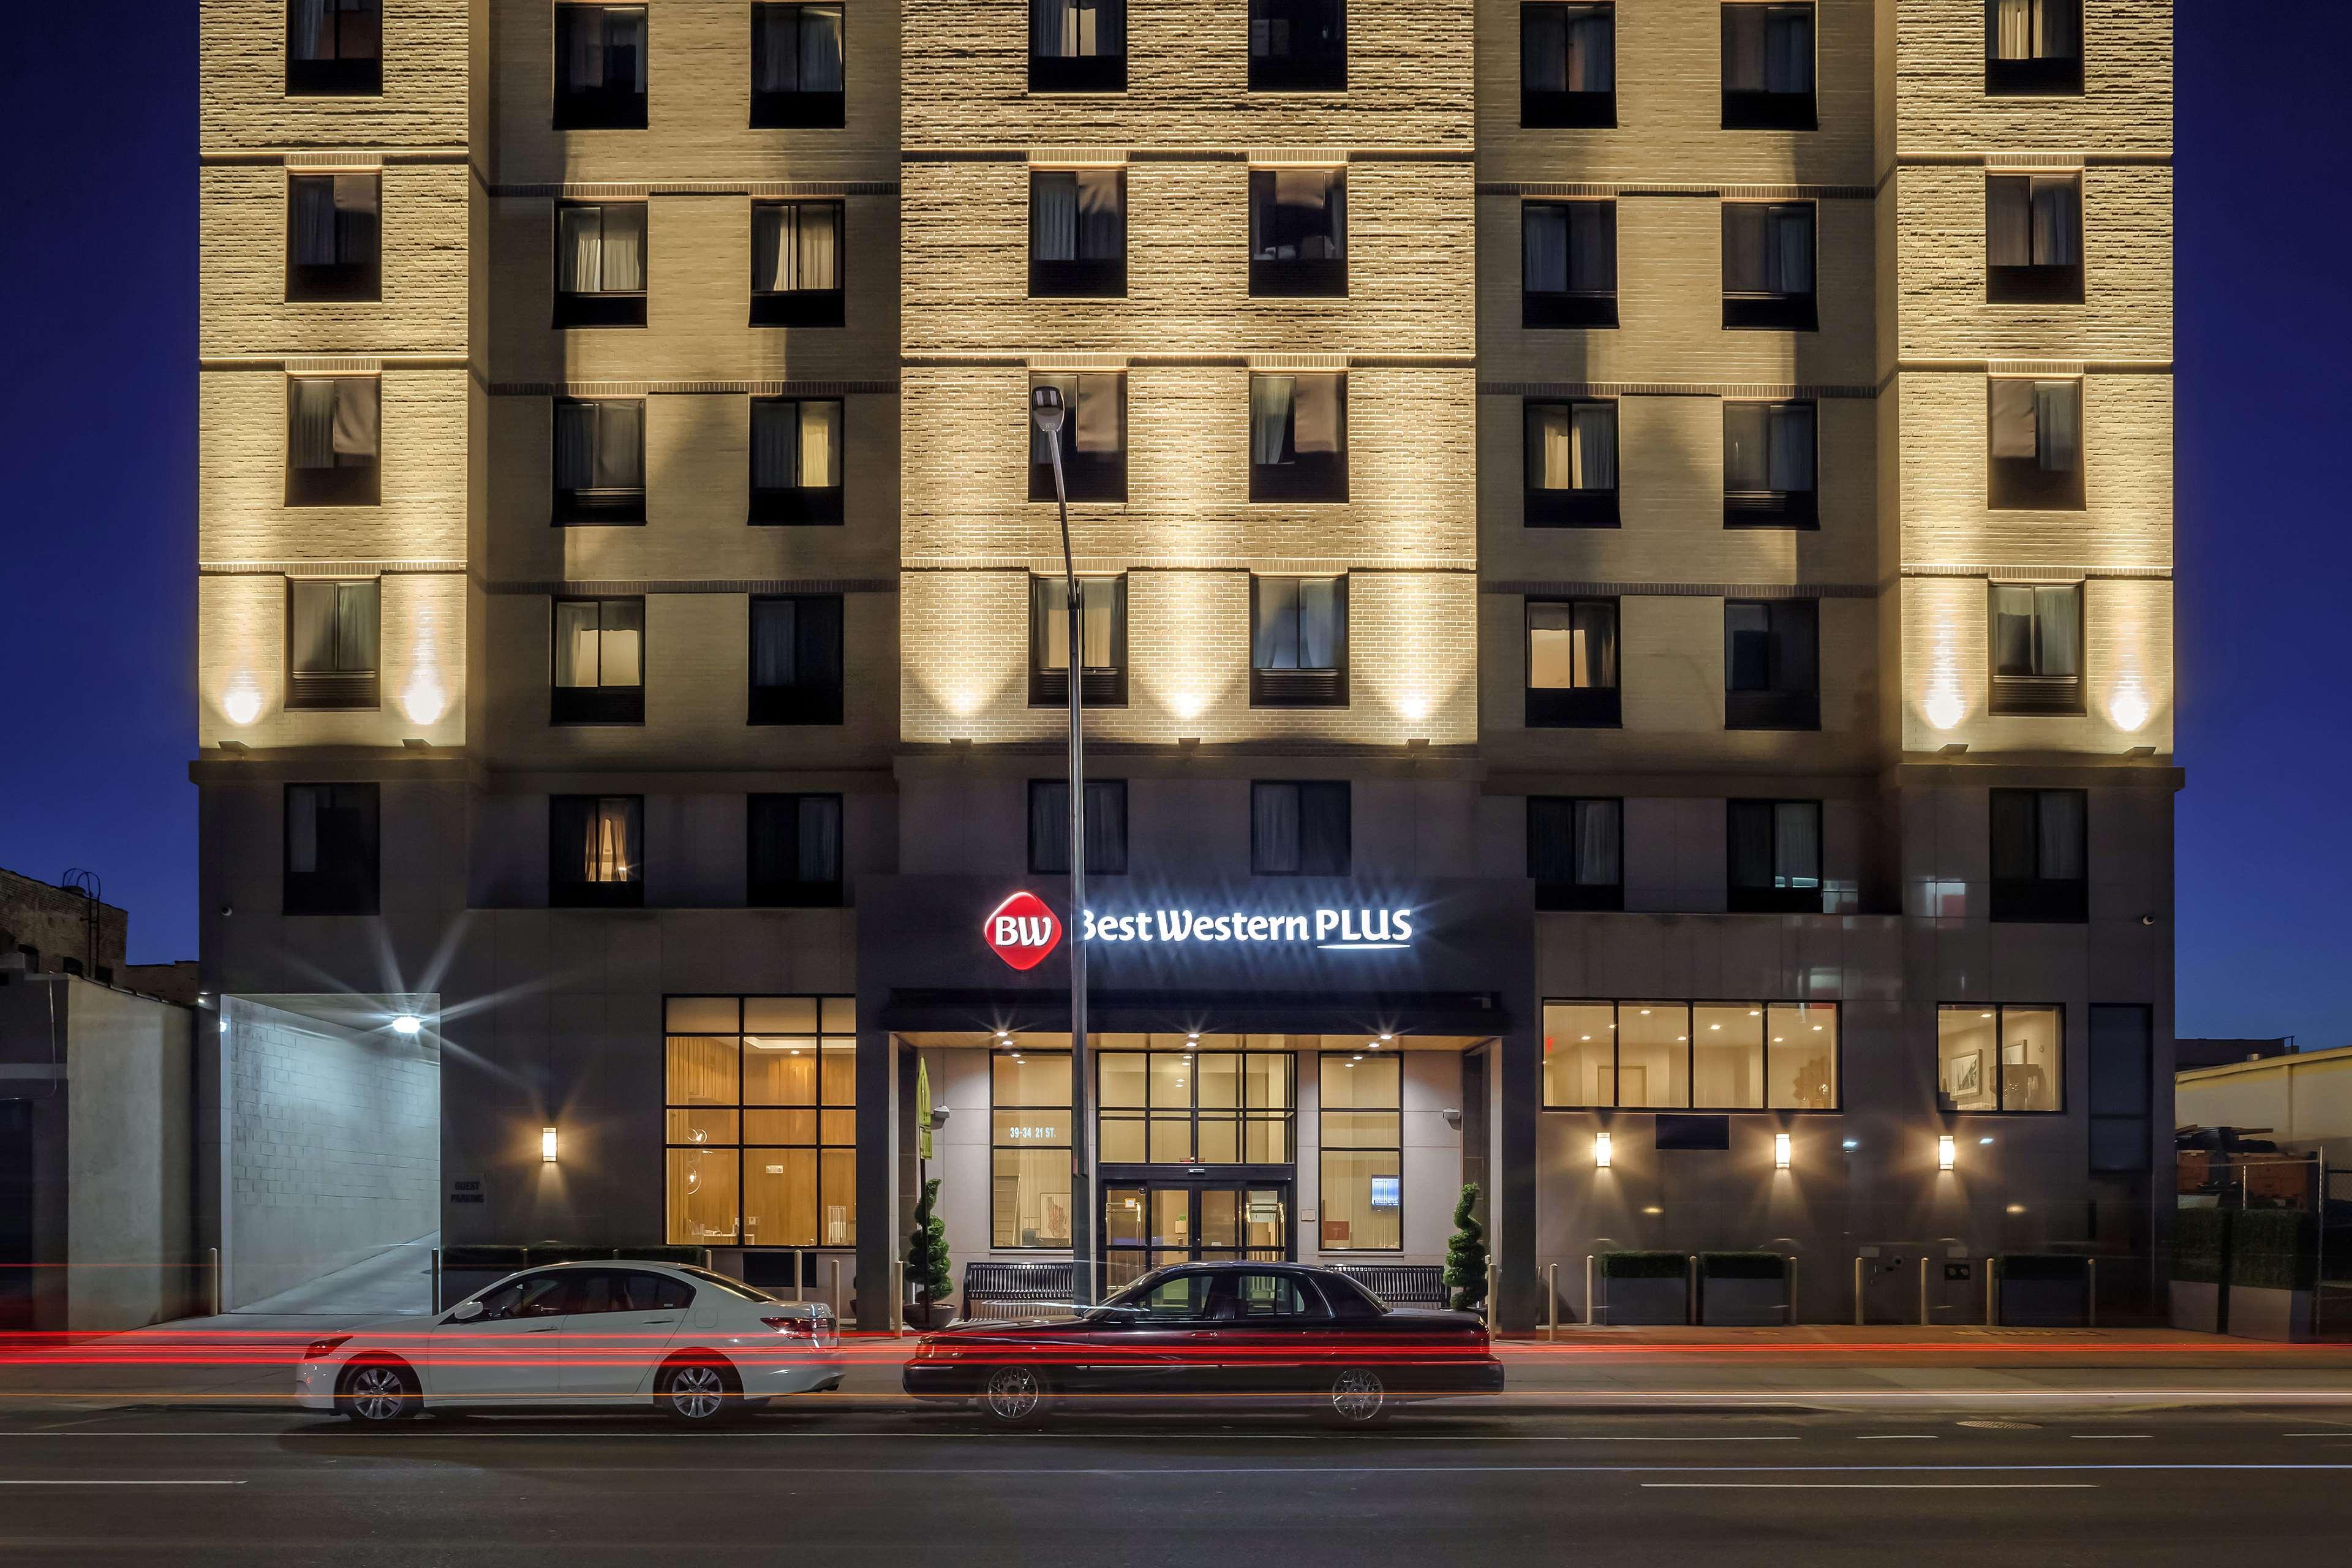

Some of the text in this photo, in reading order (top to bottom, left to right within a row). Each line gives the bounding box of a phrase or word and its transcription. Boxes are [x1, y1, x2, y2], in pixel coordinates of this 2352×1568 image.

[995, 916, 1052, 946] BW
[1156, 909, 1310, 941] Western
[1316, 909, 1412, 941] PLUS
[1010, 1126, 1031, 1138] 39-34
[1035, 1126, 1043, 1138] 21
[454, 1182, 480, 1190] GUEST
